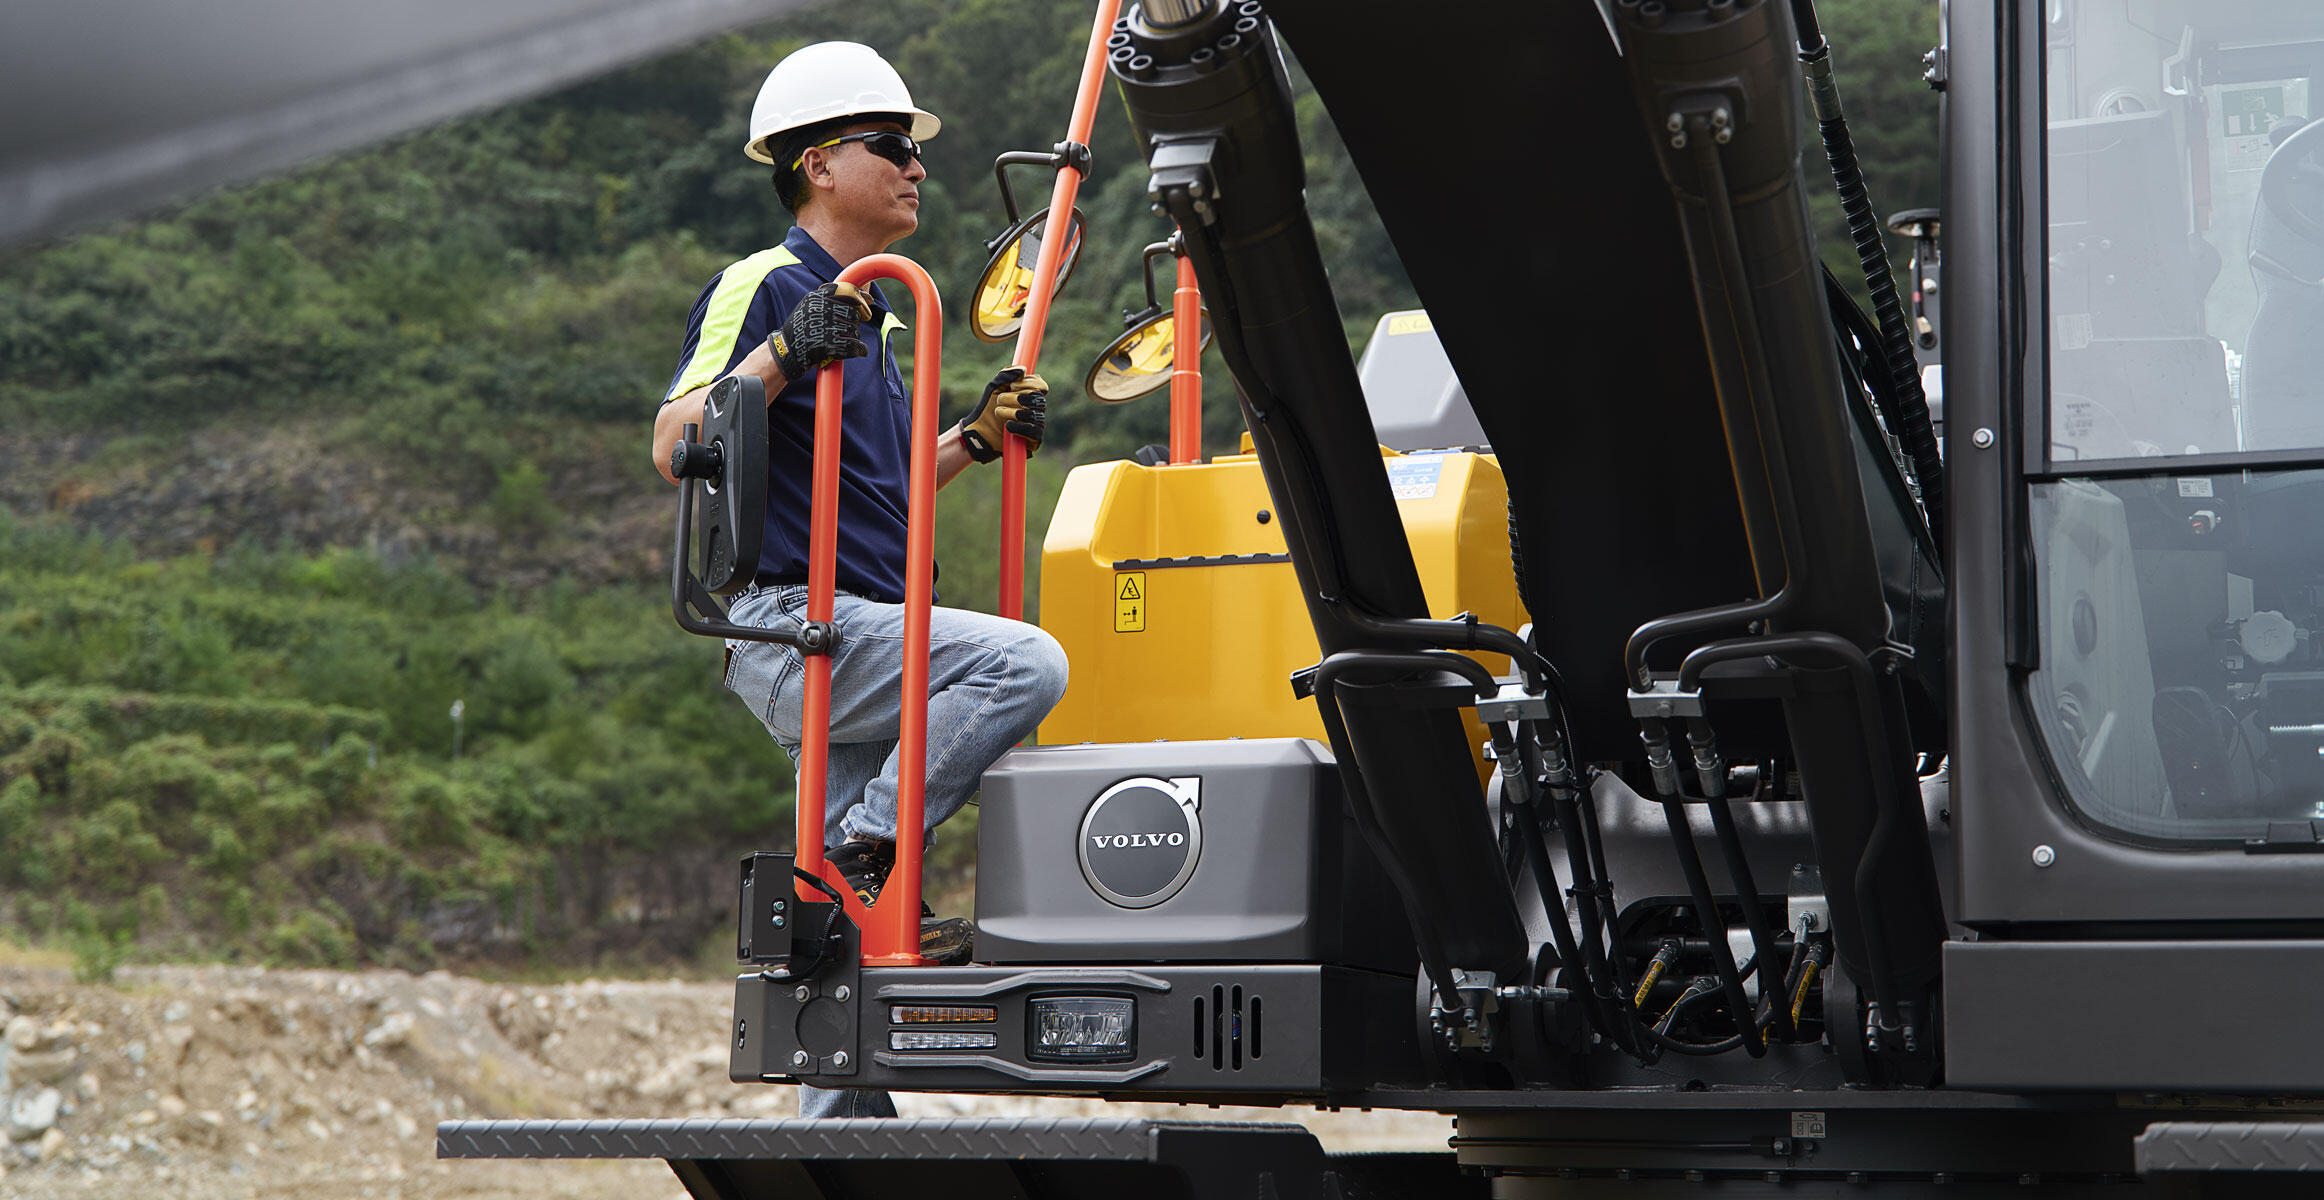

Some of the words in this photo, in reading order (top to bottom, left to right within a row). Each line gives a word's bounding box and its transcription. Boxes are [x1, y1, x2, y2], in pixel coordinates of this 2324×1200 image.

[804, 290, 825, 351] Mechanix
[1092, 832, 1184, 849] VOLVO
[920, 929, 942, 943] WALT
